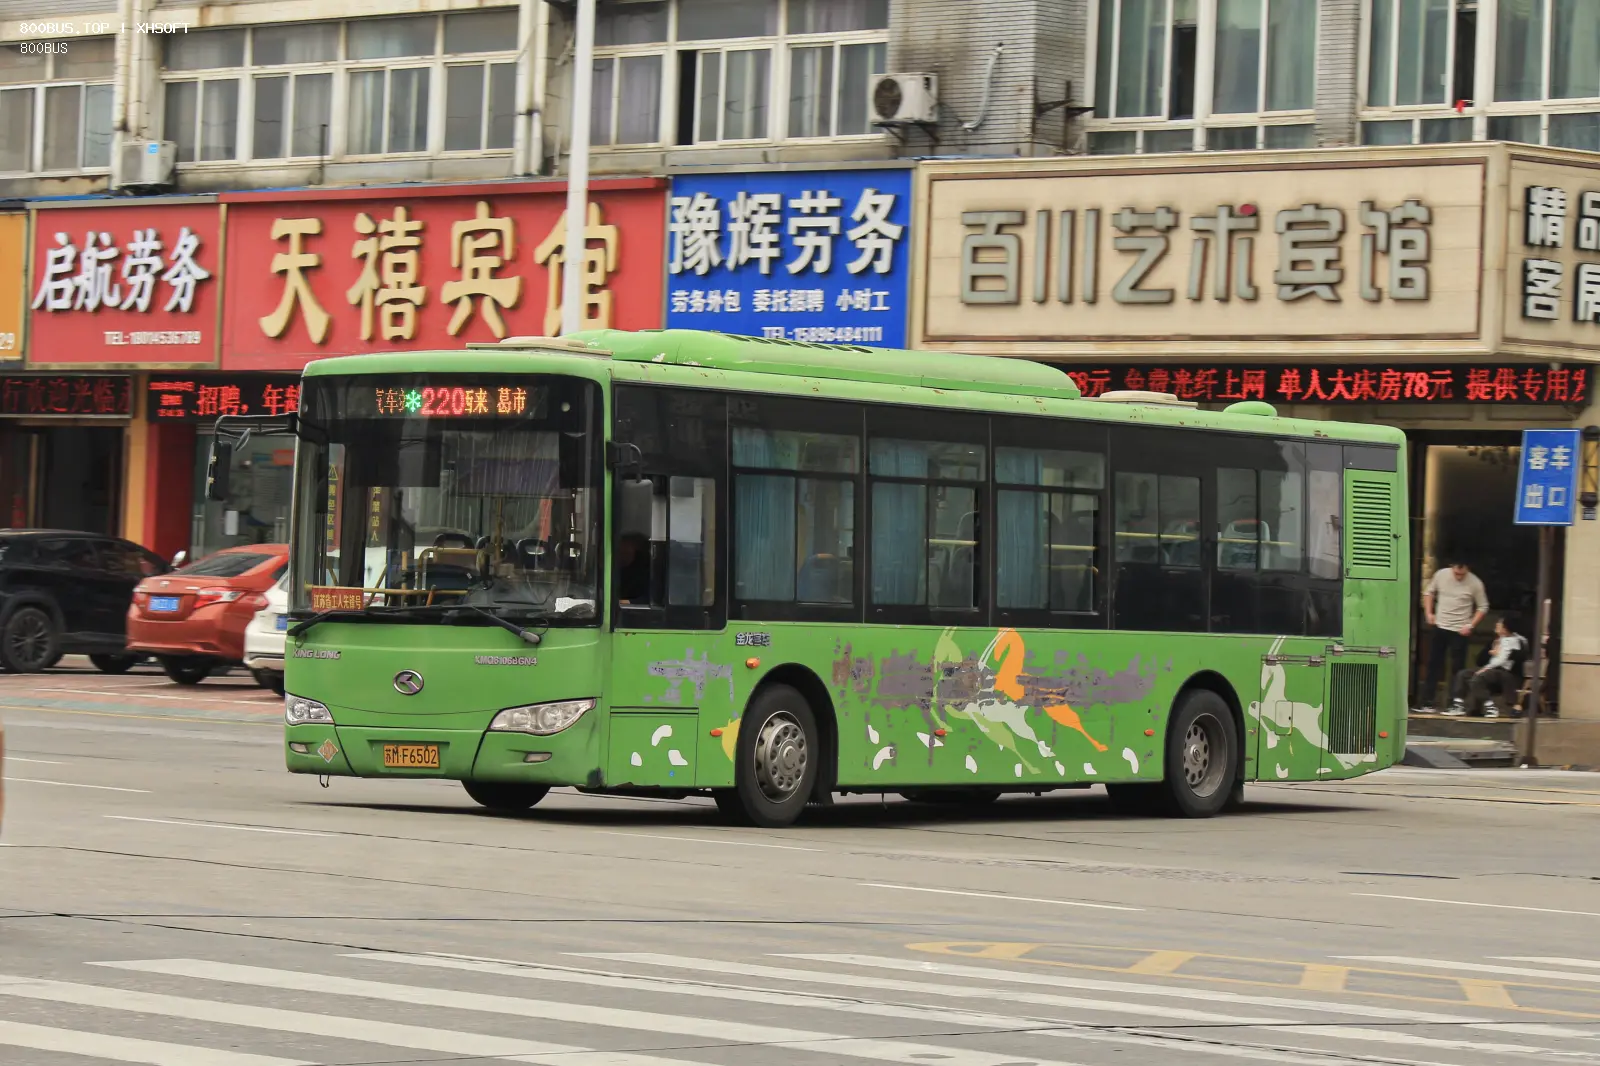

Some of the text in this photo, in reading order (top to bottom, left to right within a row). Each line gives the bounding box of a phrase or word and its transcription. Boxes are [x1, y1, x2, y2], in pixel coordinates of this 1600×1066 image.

[668, 187, 904, 275] 豫辉劳务
[960, 199, 1431, 304] 百川艺术宾馆
[31, 226, 211, 312] 启航劳务
[258, 200, 620, 344] 天禧宾馆
[671, 287, 891, 313] 劳务外包 委托招聘 小时工
[421, 387, 465, 415] 220
[1276, 368, 1454, 401] 单人大床房78元
[1527, 445, 1572, 470] 客车
[1523, 484, 1567, 509] 出口
